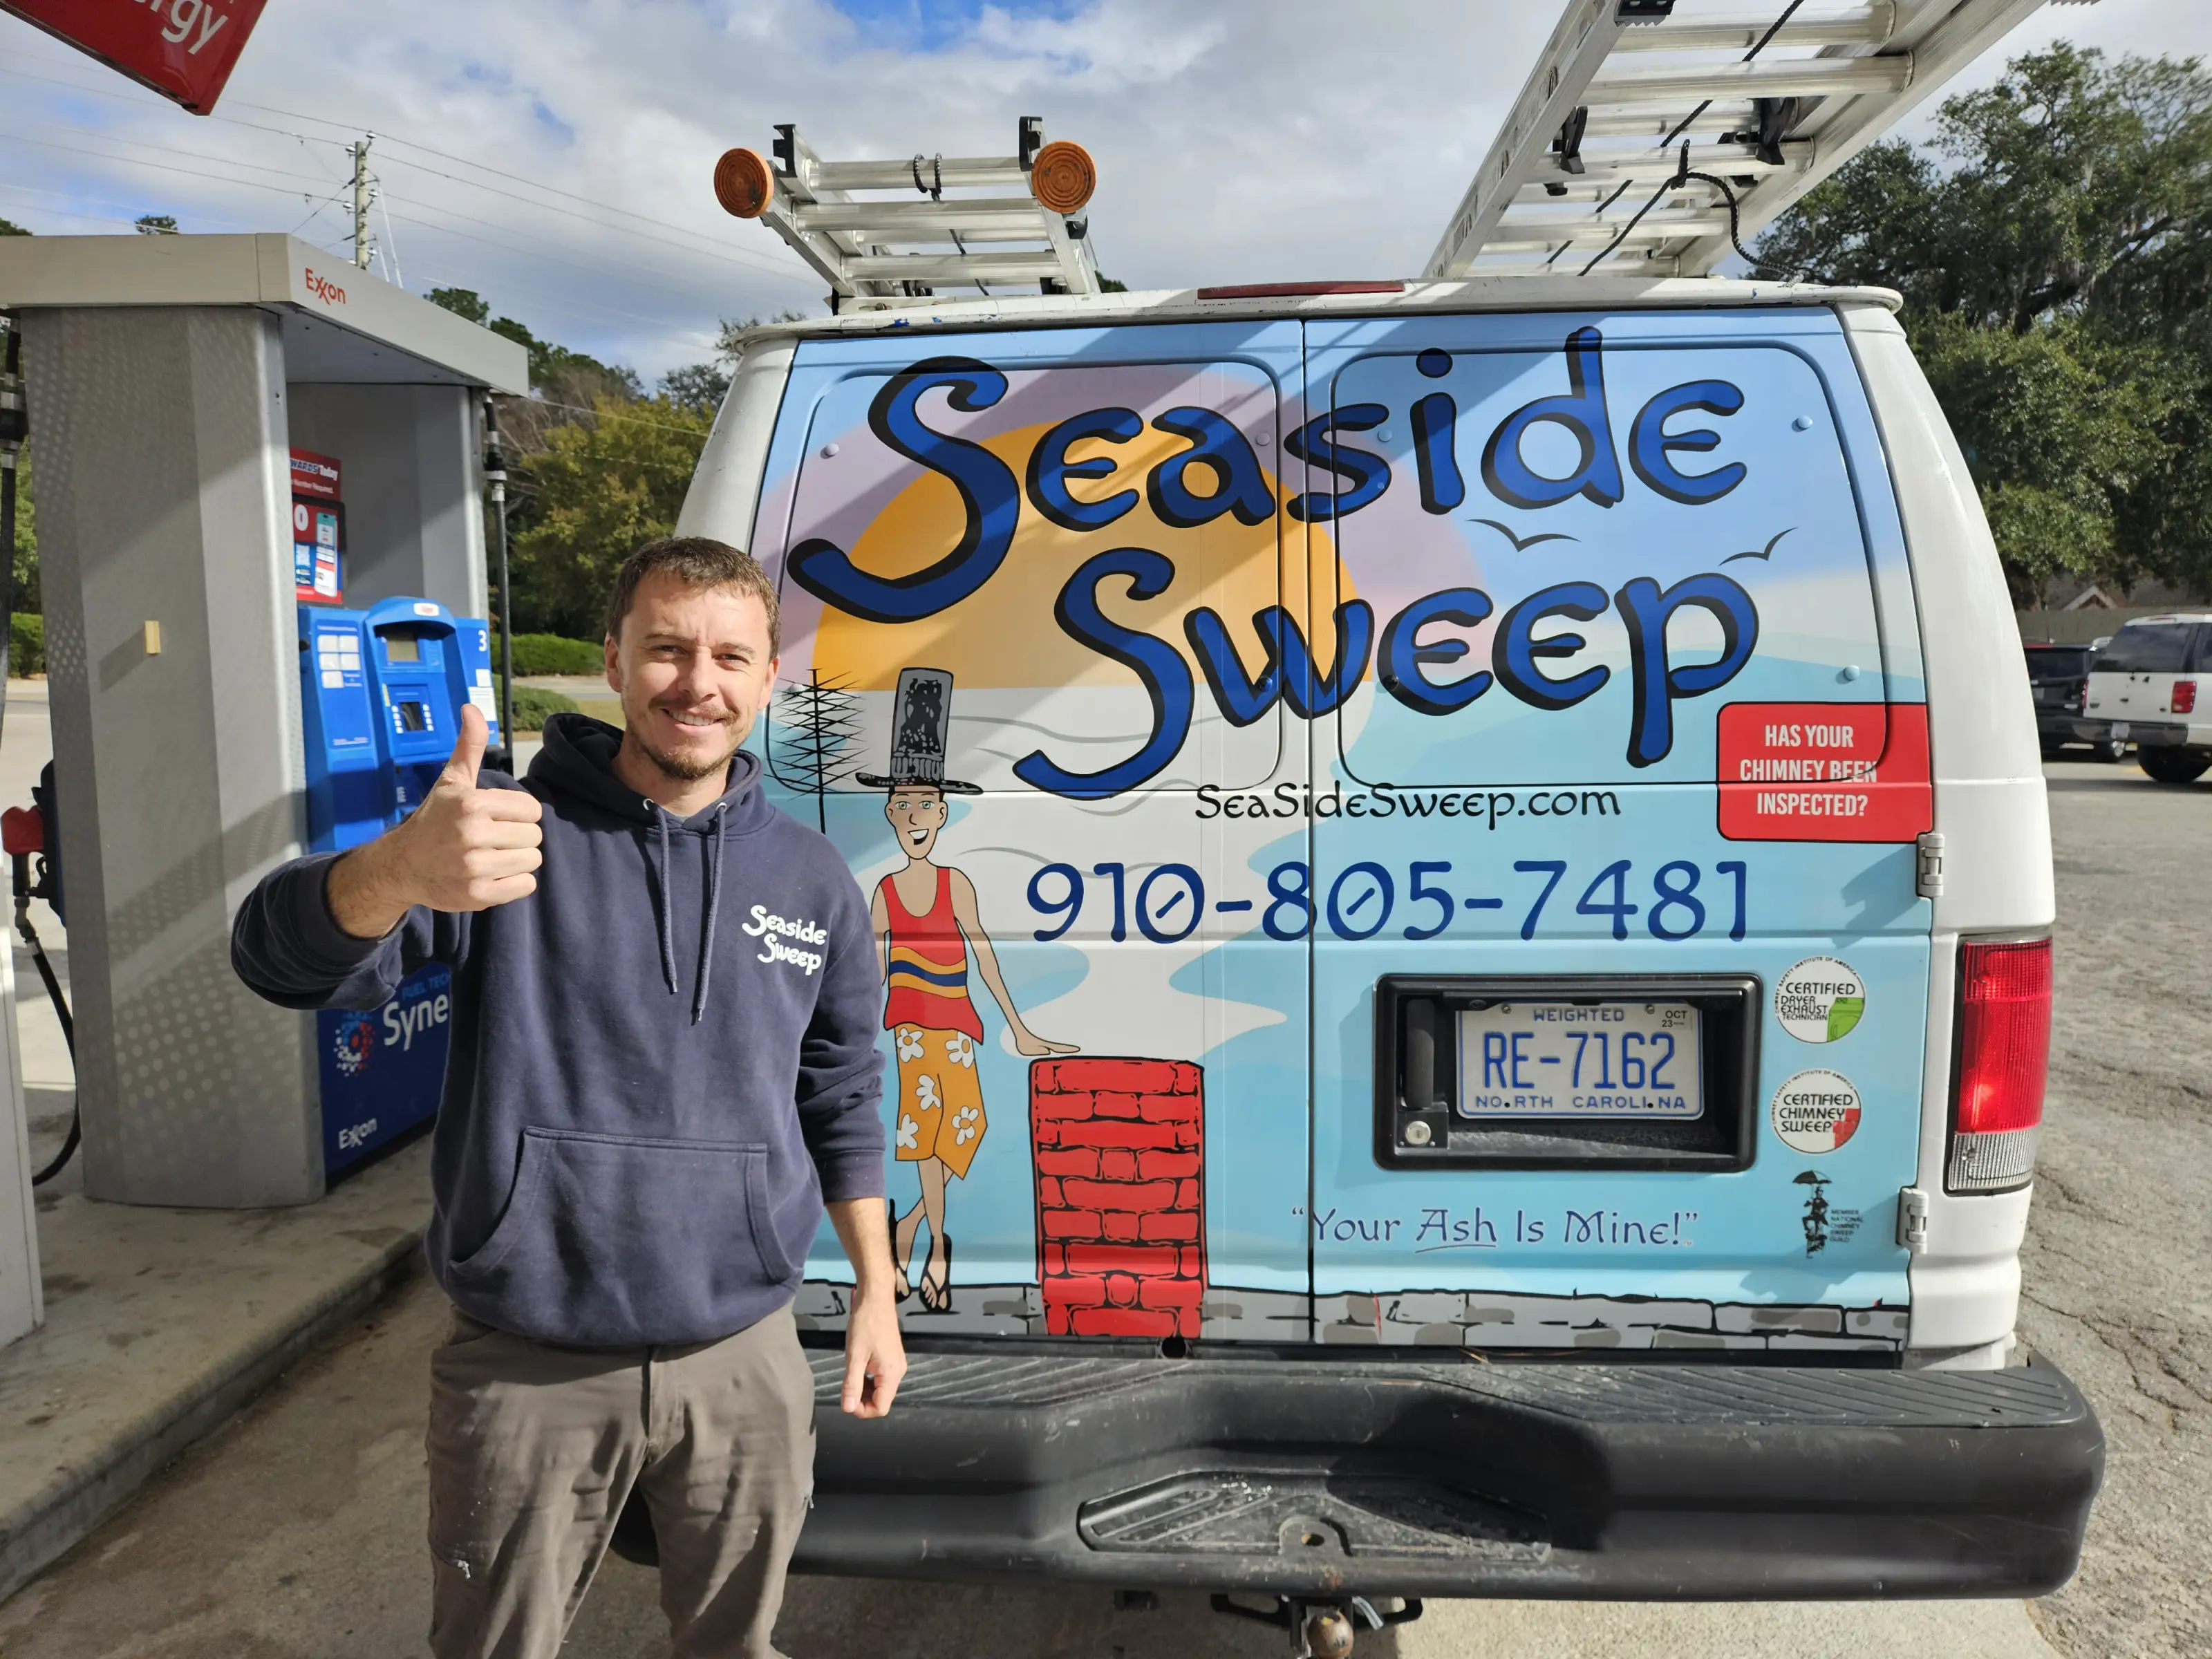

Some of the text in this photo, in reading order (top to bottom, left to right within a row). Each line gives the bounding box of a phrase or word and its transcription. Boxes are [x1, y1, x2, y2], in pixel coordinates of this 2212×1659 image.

[305, 268, 346, 305] Exxon
[787, 326, 1747, 624] Seaside
[478, 630, 487, 652] 3
[1012, 547, 1759, 801] Sweep
[1764, 724, 1854, 747] HAS YOUR
[1740, 759, 1877, 783] CHIMNEY BEEN
[1194, 780, 1621, 830] SeaSideSweep.com
[1756, 792, 1868, 817] INSPECTED?
[1027, 859, 1747, 944] 910-805-7481
[742, 904, 827, 945] Seaside
[757, 933, 822, 975] Sweep
[1781, 995, 1816, 1005] DRYER
[1785, 982, 1856, 995] CERTIFIED
[1533, 1009, 1624, 1022] WEIGHTED
[1665, 1010, 1688, 1020] OCT
[1781, 1004, 1828, 1014] EXHAUST
[1782, 1013, 1828, 1021] TECHNICIAN
[1661, 1019, 1673, 1028] 23
[1483, 1031, 1676, 1089] RE-7162
[1476, 1096, 1687, 1109] NORTH CAROLINA
[1783, 1094, 1853, 1106] CERTIFIED
[1779, 1107, 1845, 1120] CHIMNEY
[338, 1118, 377, 1150] Exxon
[1781, 1121, 1832, 1133] SWEEP
[1415, 1207, 1498, 1243] Ash
[1515, 1209, 1545, 1243] Is
